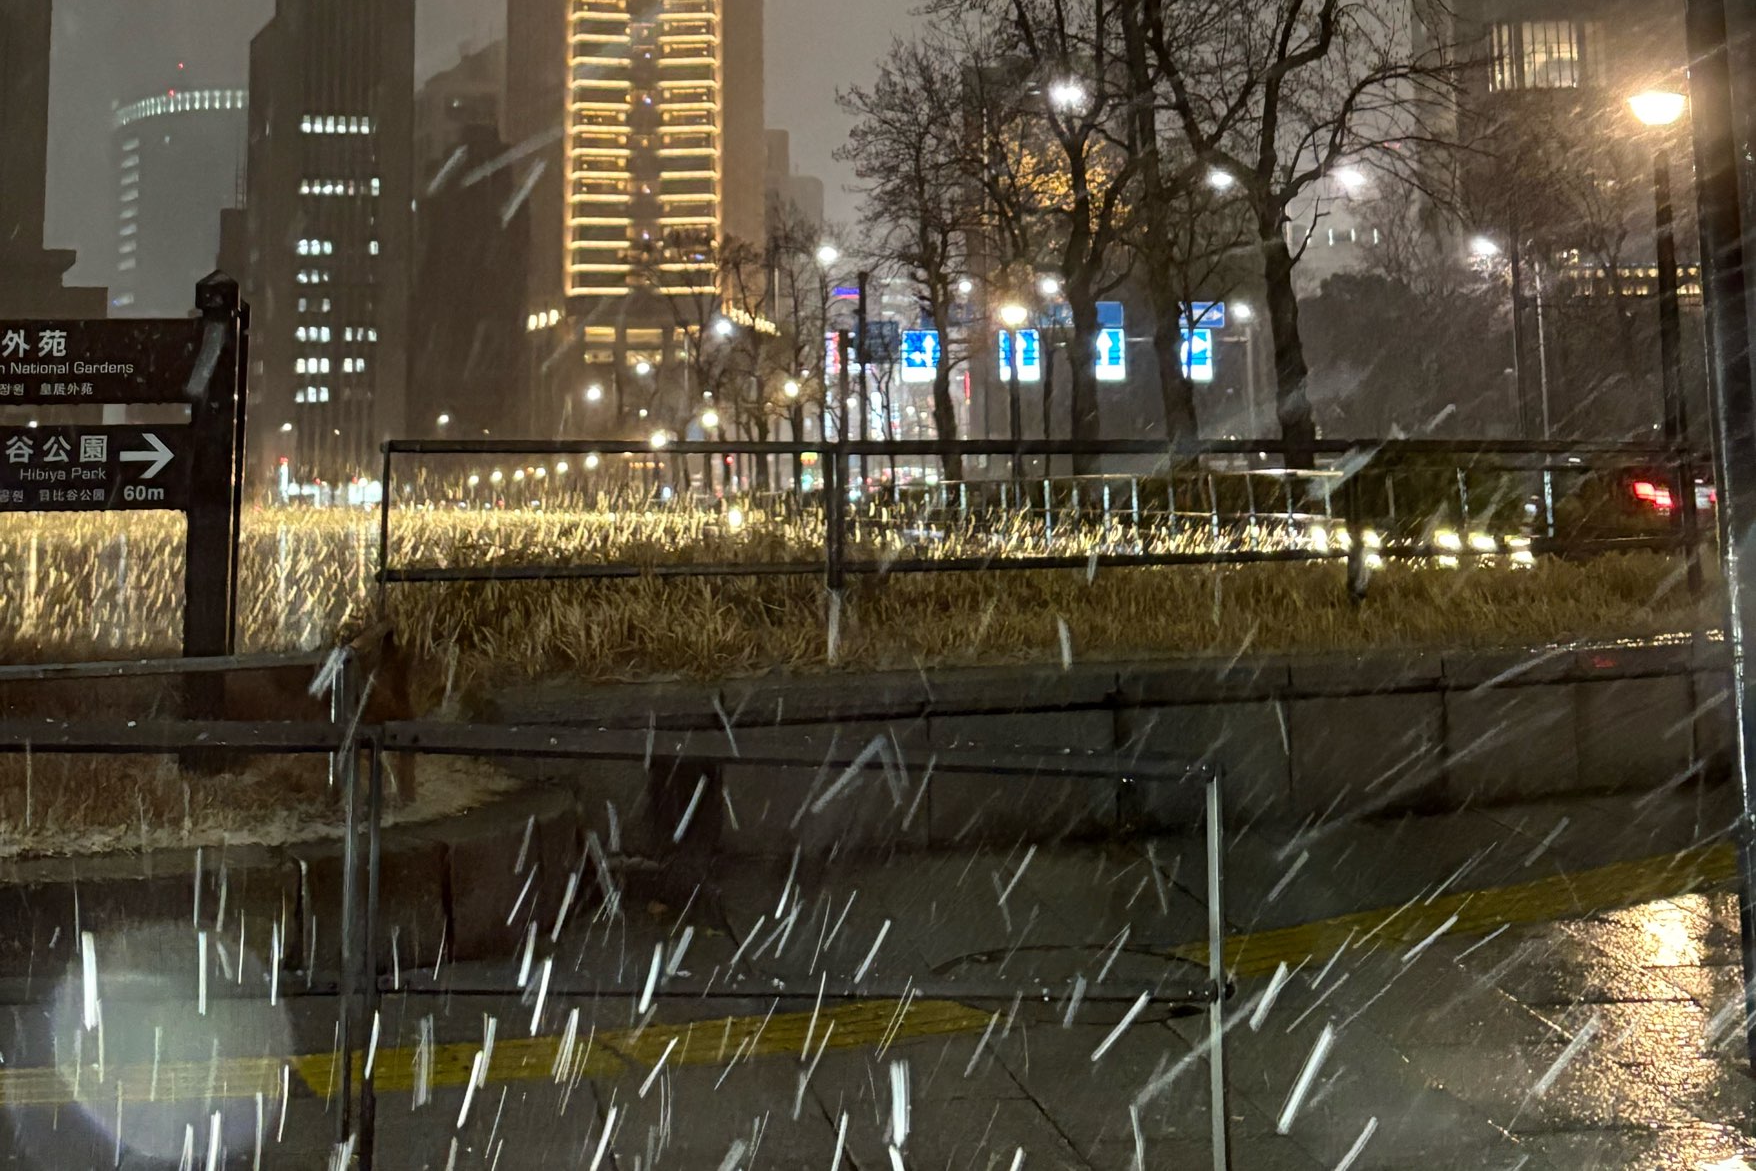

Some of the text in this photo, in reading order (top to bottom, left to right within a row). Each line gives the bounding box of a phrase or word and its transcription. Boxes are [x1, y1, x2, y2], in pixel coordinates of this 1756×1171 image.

[2, 329, 67, 358] 外苑
[10, 361, 69, 374] National
[74, 361, 134, 374] Gardens
[40, 383, 93, 396] 皇居外苑
[5, 435, 108, 463] 谷公園
[20, 467, 106, 483] Hibiya Park
[124, 485, 164, 501] 60m
